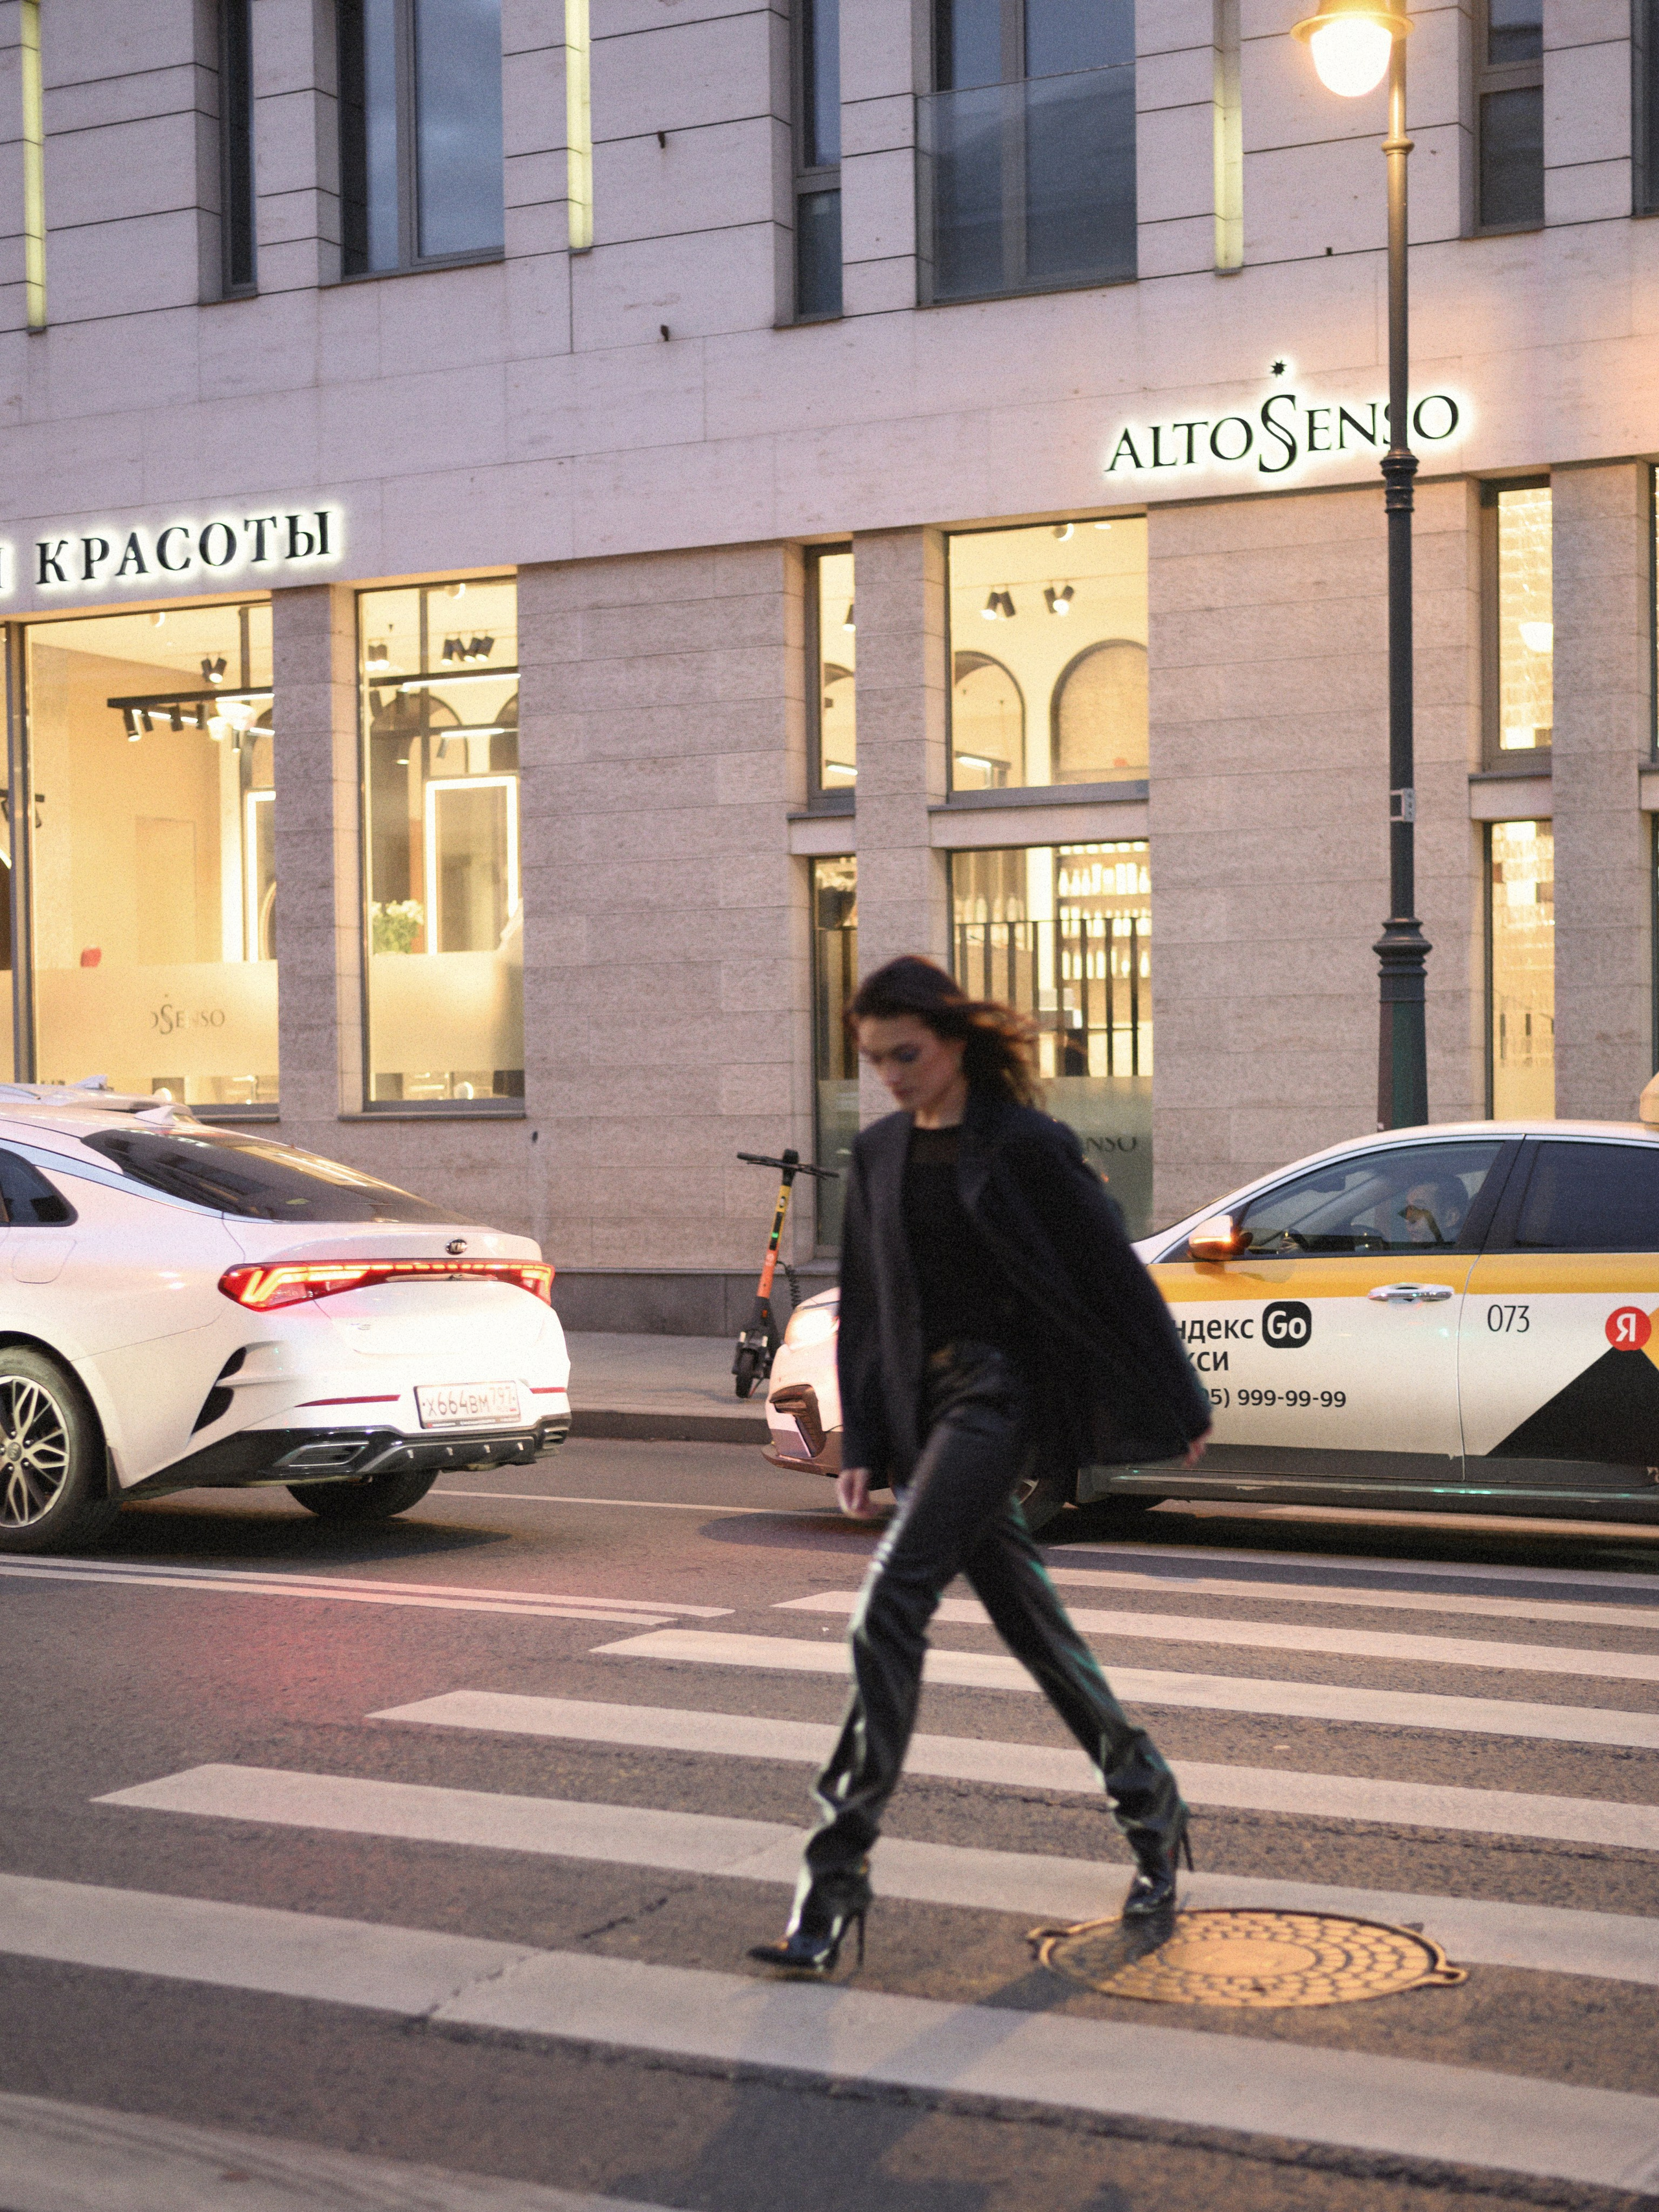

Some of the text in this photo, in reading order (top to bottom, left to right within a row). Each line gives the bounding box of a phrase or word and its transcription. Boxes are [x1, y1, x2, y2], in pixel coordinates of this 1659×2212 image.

[1103, 394, 1459, 473] ALTOSENO
[35, 511, 332, 585] КРАСОТЫ
[1267, 1310, 1307, 1339] Go
[1487, 1304, 1530, 1333] 073
[1616, 1312, 1636, 1342] Я
[1203, 1388, 1346, 1408] 5) 999-99-99
